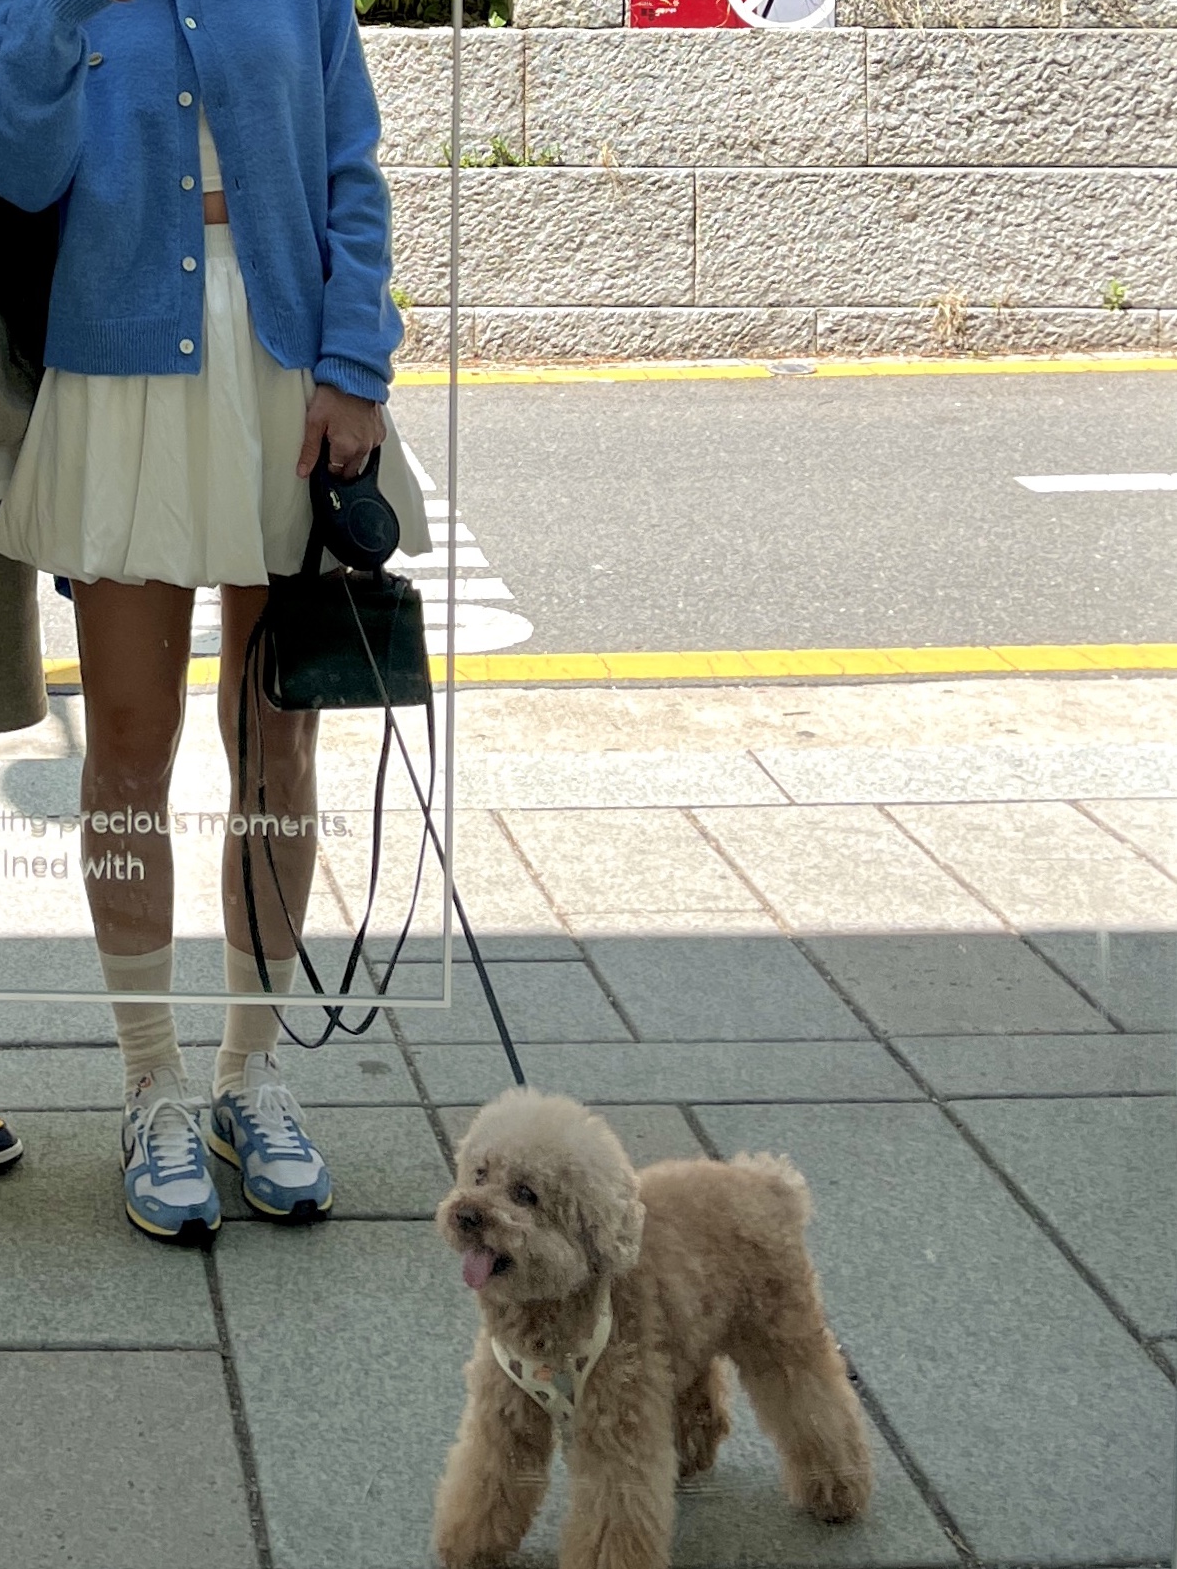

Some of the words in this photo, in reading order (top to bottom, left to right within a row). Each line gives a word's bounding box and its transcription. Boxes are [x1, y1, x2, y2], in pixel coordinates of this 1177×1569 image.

[59, 805, 189, 838] precious
[197, 810, 355, 838] moments.
[79, 849, 146, 881] with
